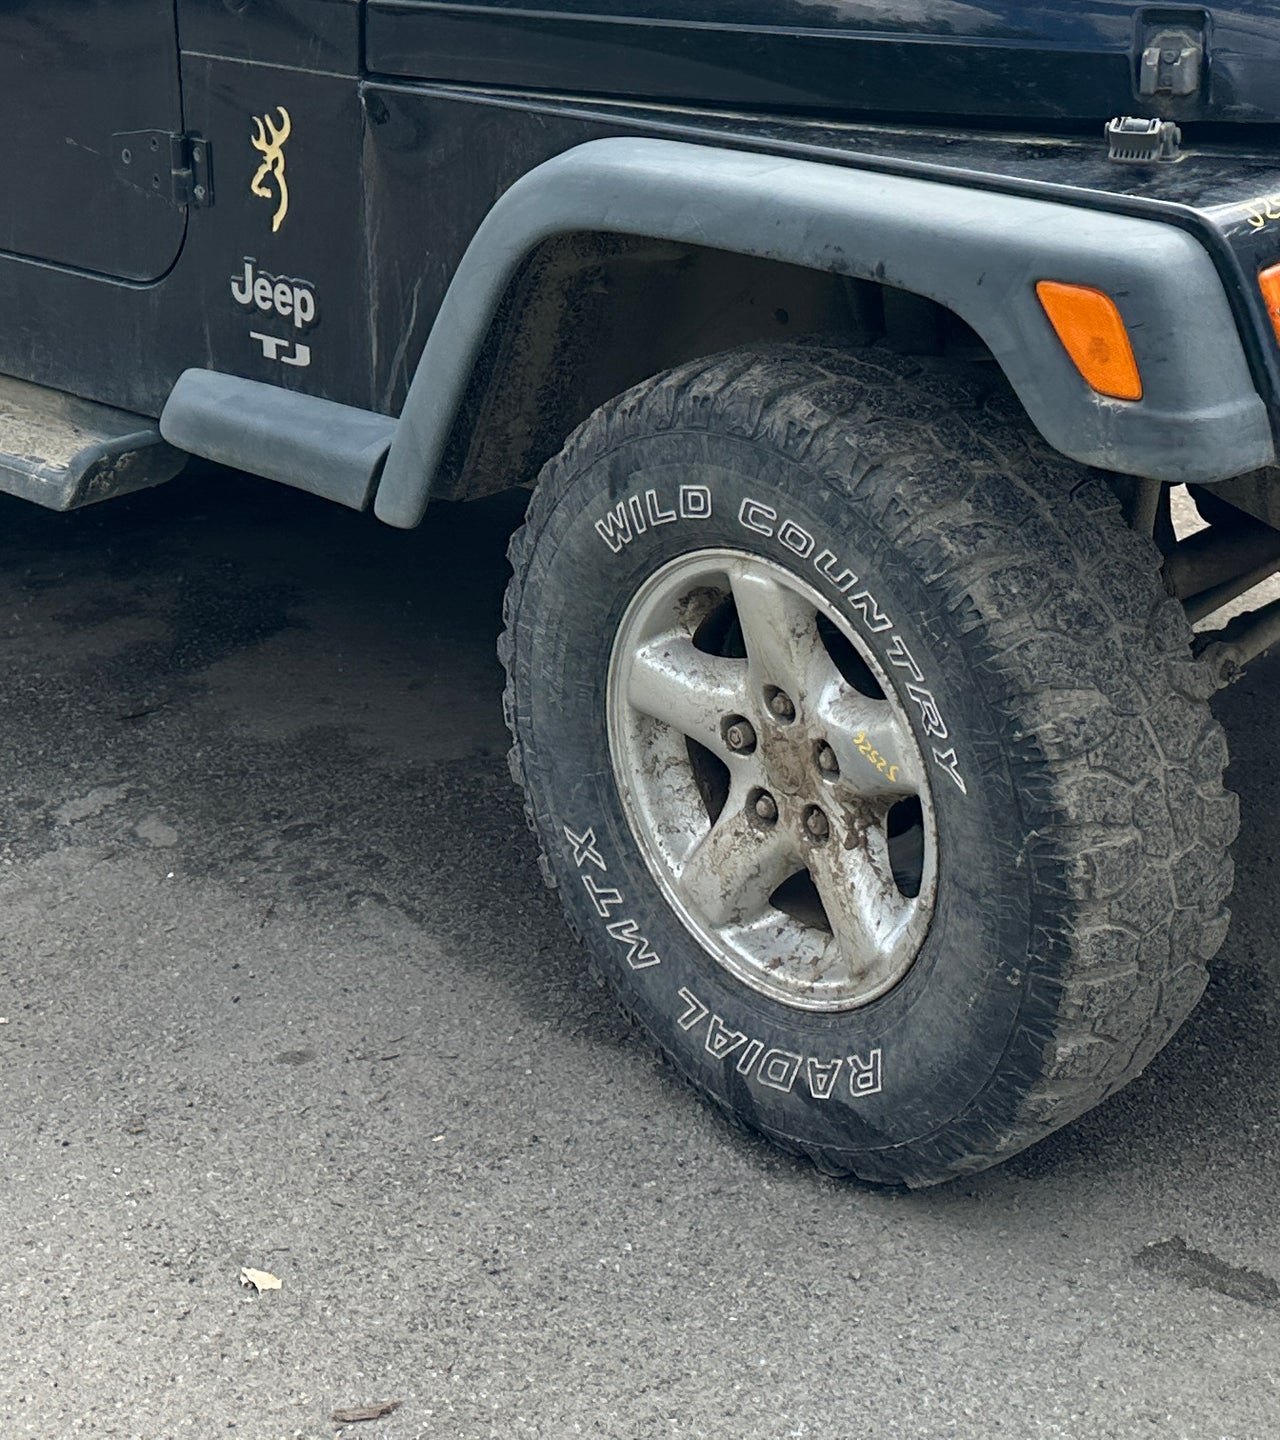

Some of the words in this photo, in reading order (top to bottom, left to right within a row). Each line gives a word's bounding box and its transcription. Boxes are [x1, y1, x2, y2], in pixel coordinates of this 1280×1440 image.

[230, 257, 316, 329] Jeep
[249, 331, 312, 367] TJ
[594, 484, 713, 554] WILD
[737, 496, 968, 796] COUNTRY
[562, 825, 661, 971] MTX
[677, 986, 882, 1100] RADIAL
